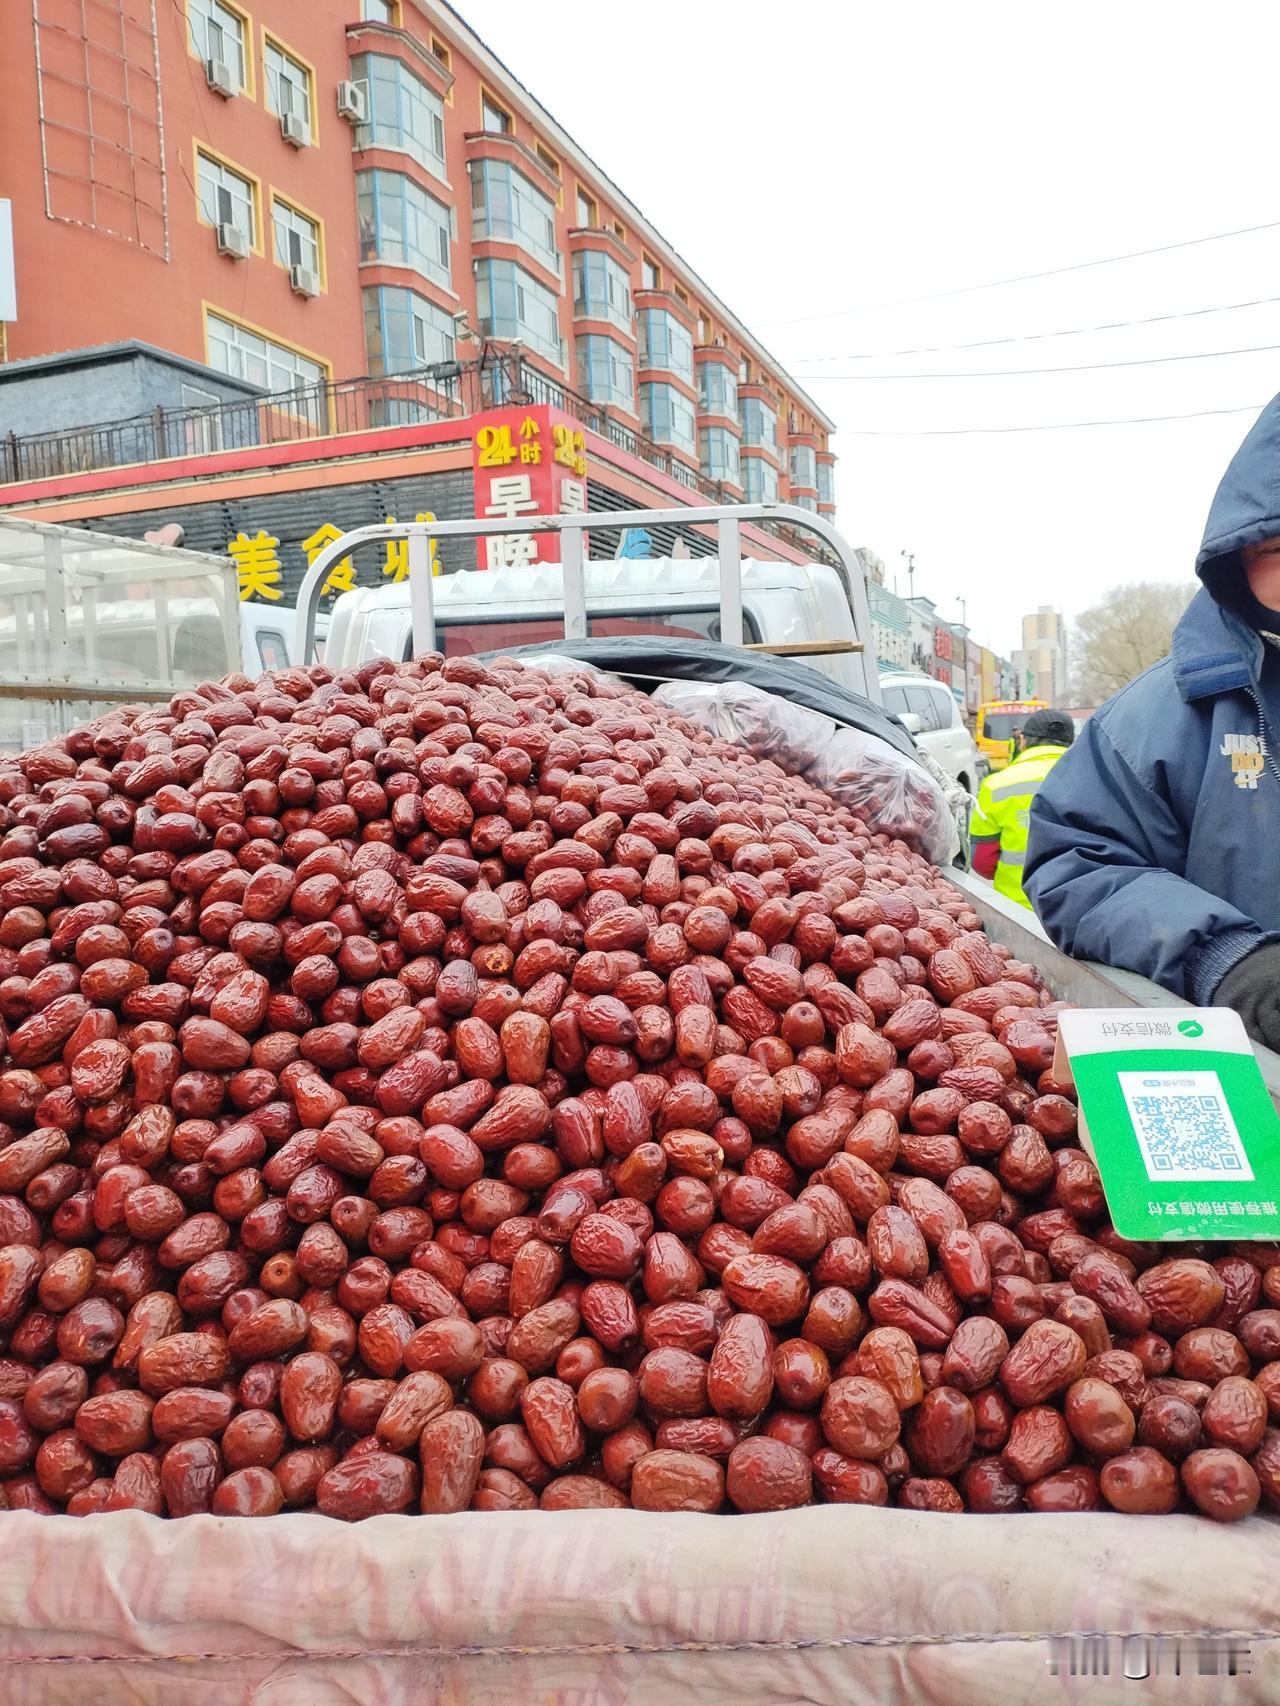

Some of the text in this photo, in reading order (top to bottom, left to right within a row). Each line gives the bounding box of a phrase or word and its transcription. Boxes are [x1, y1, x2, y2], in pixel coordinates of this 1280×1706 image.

[1101, 1022, 1173, 1037] 微信支付
[1147, 1201, 1279, 1216] 推荐使用微信支付
